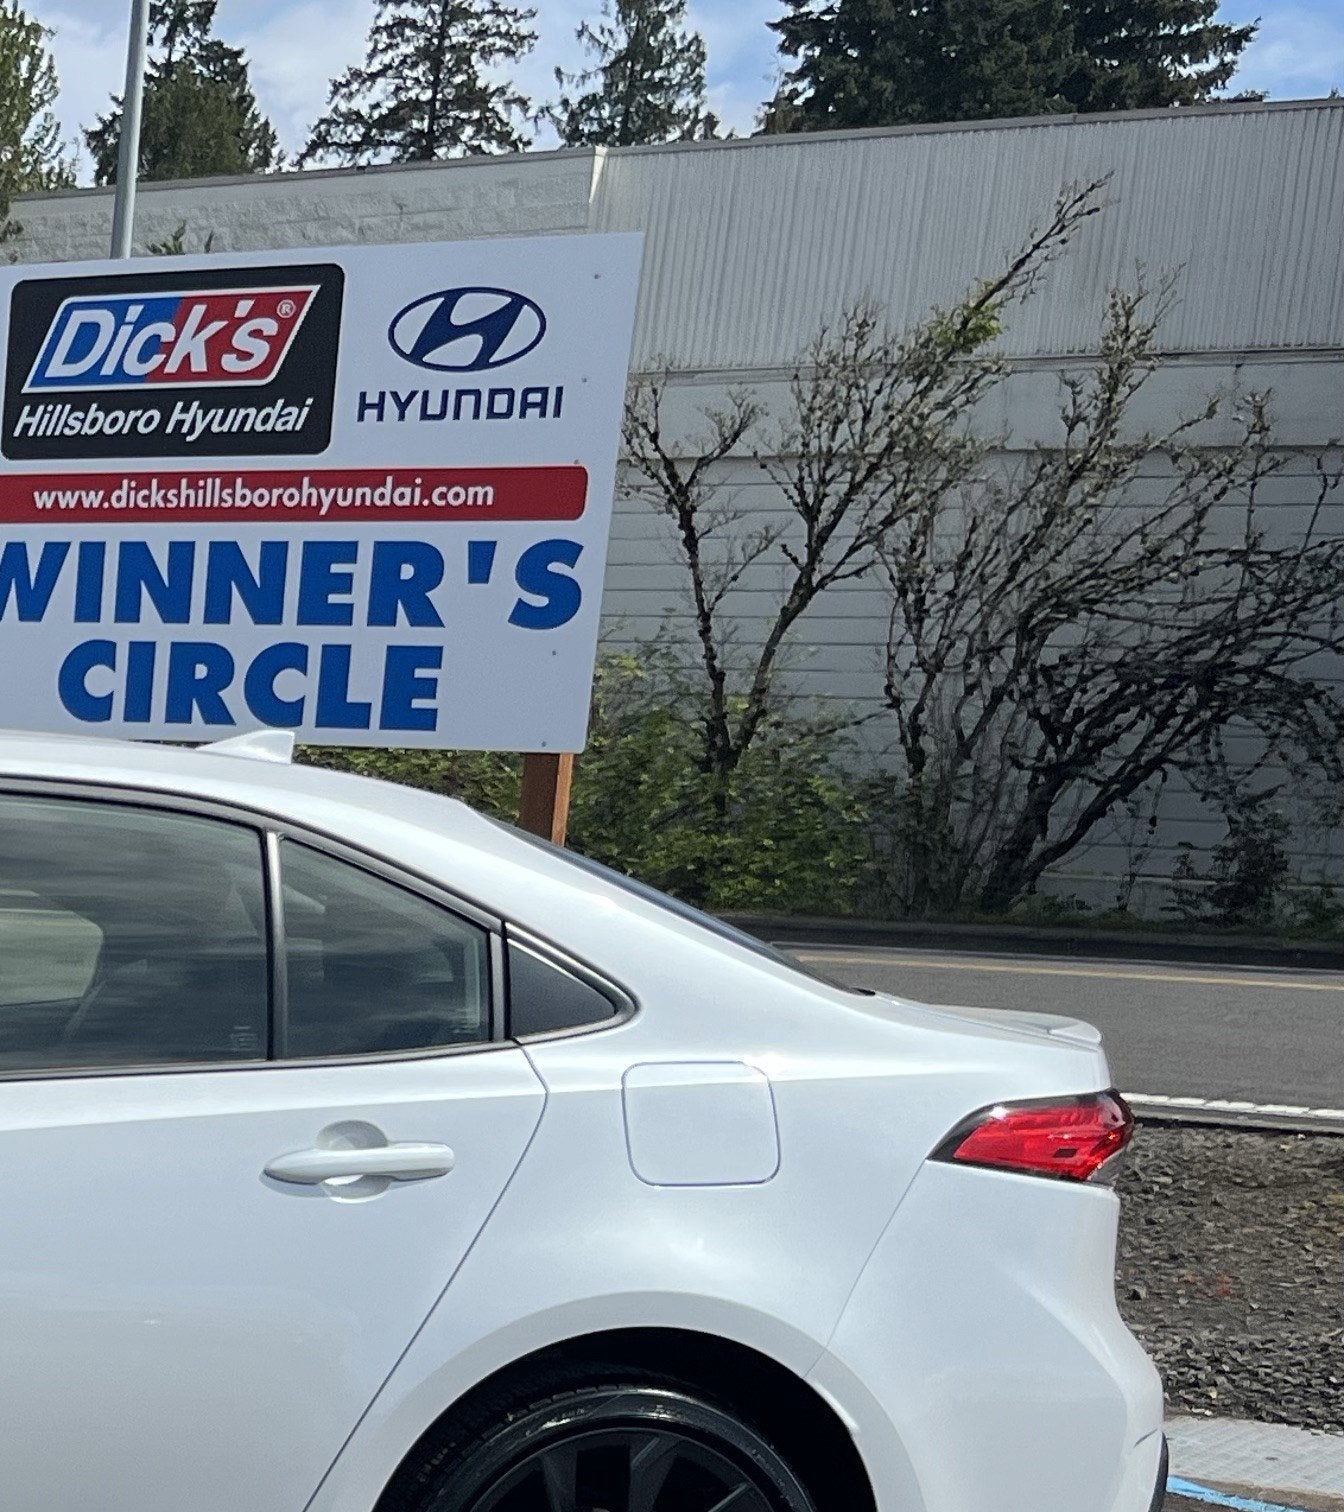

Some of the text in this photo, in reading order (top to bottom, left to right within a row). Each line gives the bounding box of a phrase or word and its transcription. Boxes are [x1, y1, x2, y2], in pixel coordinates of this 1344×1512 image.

[12, 398, 314, 442] Hillsboro Hyundai
[357, 386, 564, 423] HYUNDAI
[33, 478, 494, 512] www.dickshillsborohyundai.com
[57, 640, 444, 732] CIRCLE
